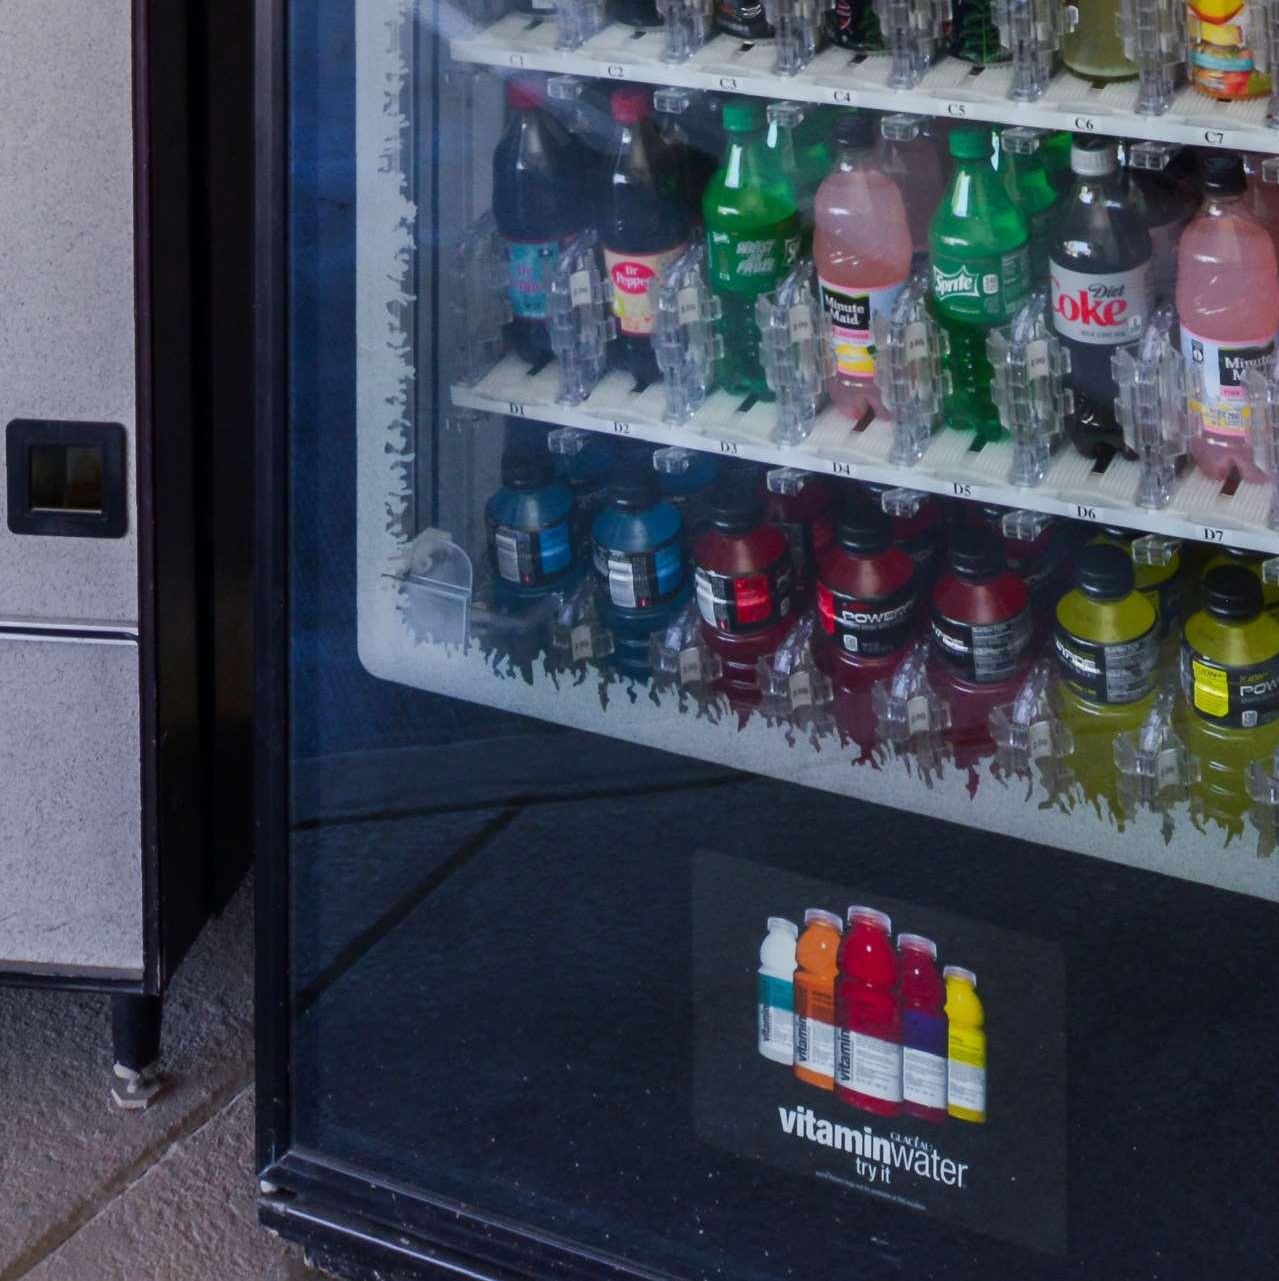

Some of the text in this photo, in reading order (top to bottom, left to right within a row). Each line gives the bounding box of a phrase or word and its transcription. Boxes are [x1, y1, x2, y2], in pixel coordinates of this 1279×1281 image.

[608, 64, 625, 76] C2
[719, 77, 736, 90] C3
[833, 90, 851, 103] C4
[948, 102, 966, 115] C5
[1074, 117, 1094, 131] C6
[1204, 130, 1224, 144] C7
[934, 274, 973, 295] Sprite
[1088, 283, 1124, 299] Diet
[825, 294, 865, 313] Minute
[831, 309, 859, 326] Maid
[613, 421, 630, 434] D2
[720, 441, 738, 454] D3
[833, 462, 851, 475] D4
[952, 482, 971, 496] D5
[1077, 505, 1096, 519] D6
[1204, 528, 1224, 543] D7
[838, 1029, 850, 1081] vitamin
[778, 1106, 968, 1188] vitaminwater
[856, 1157, 891, 1184] try it
